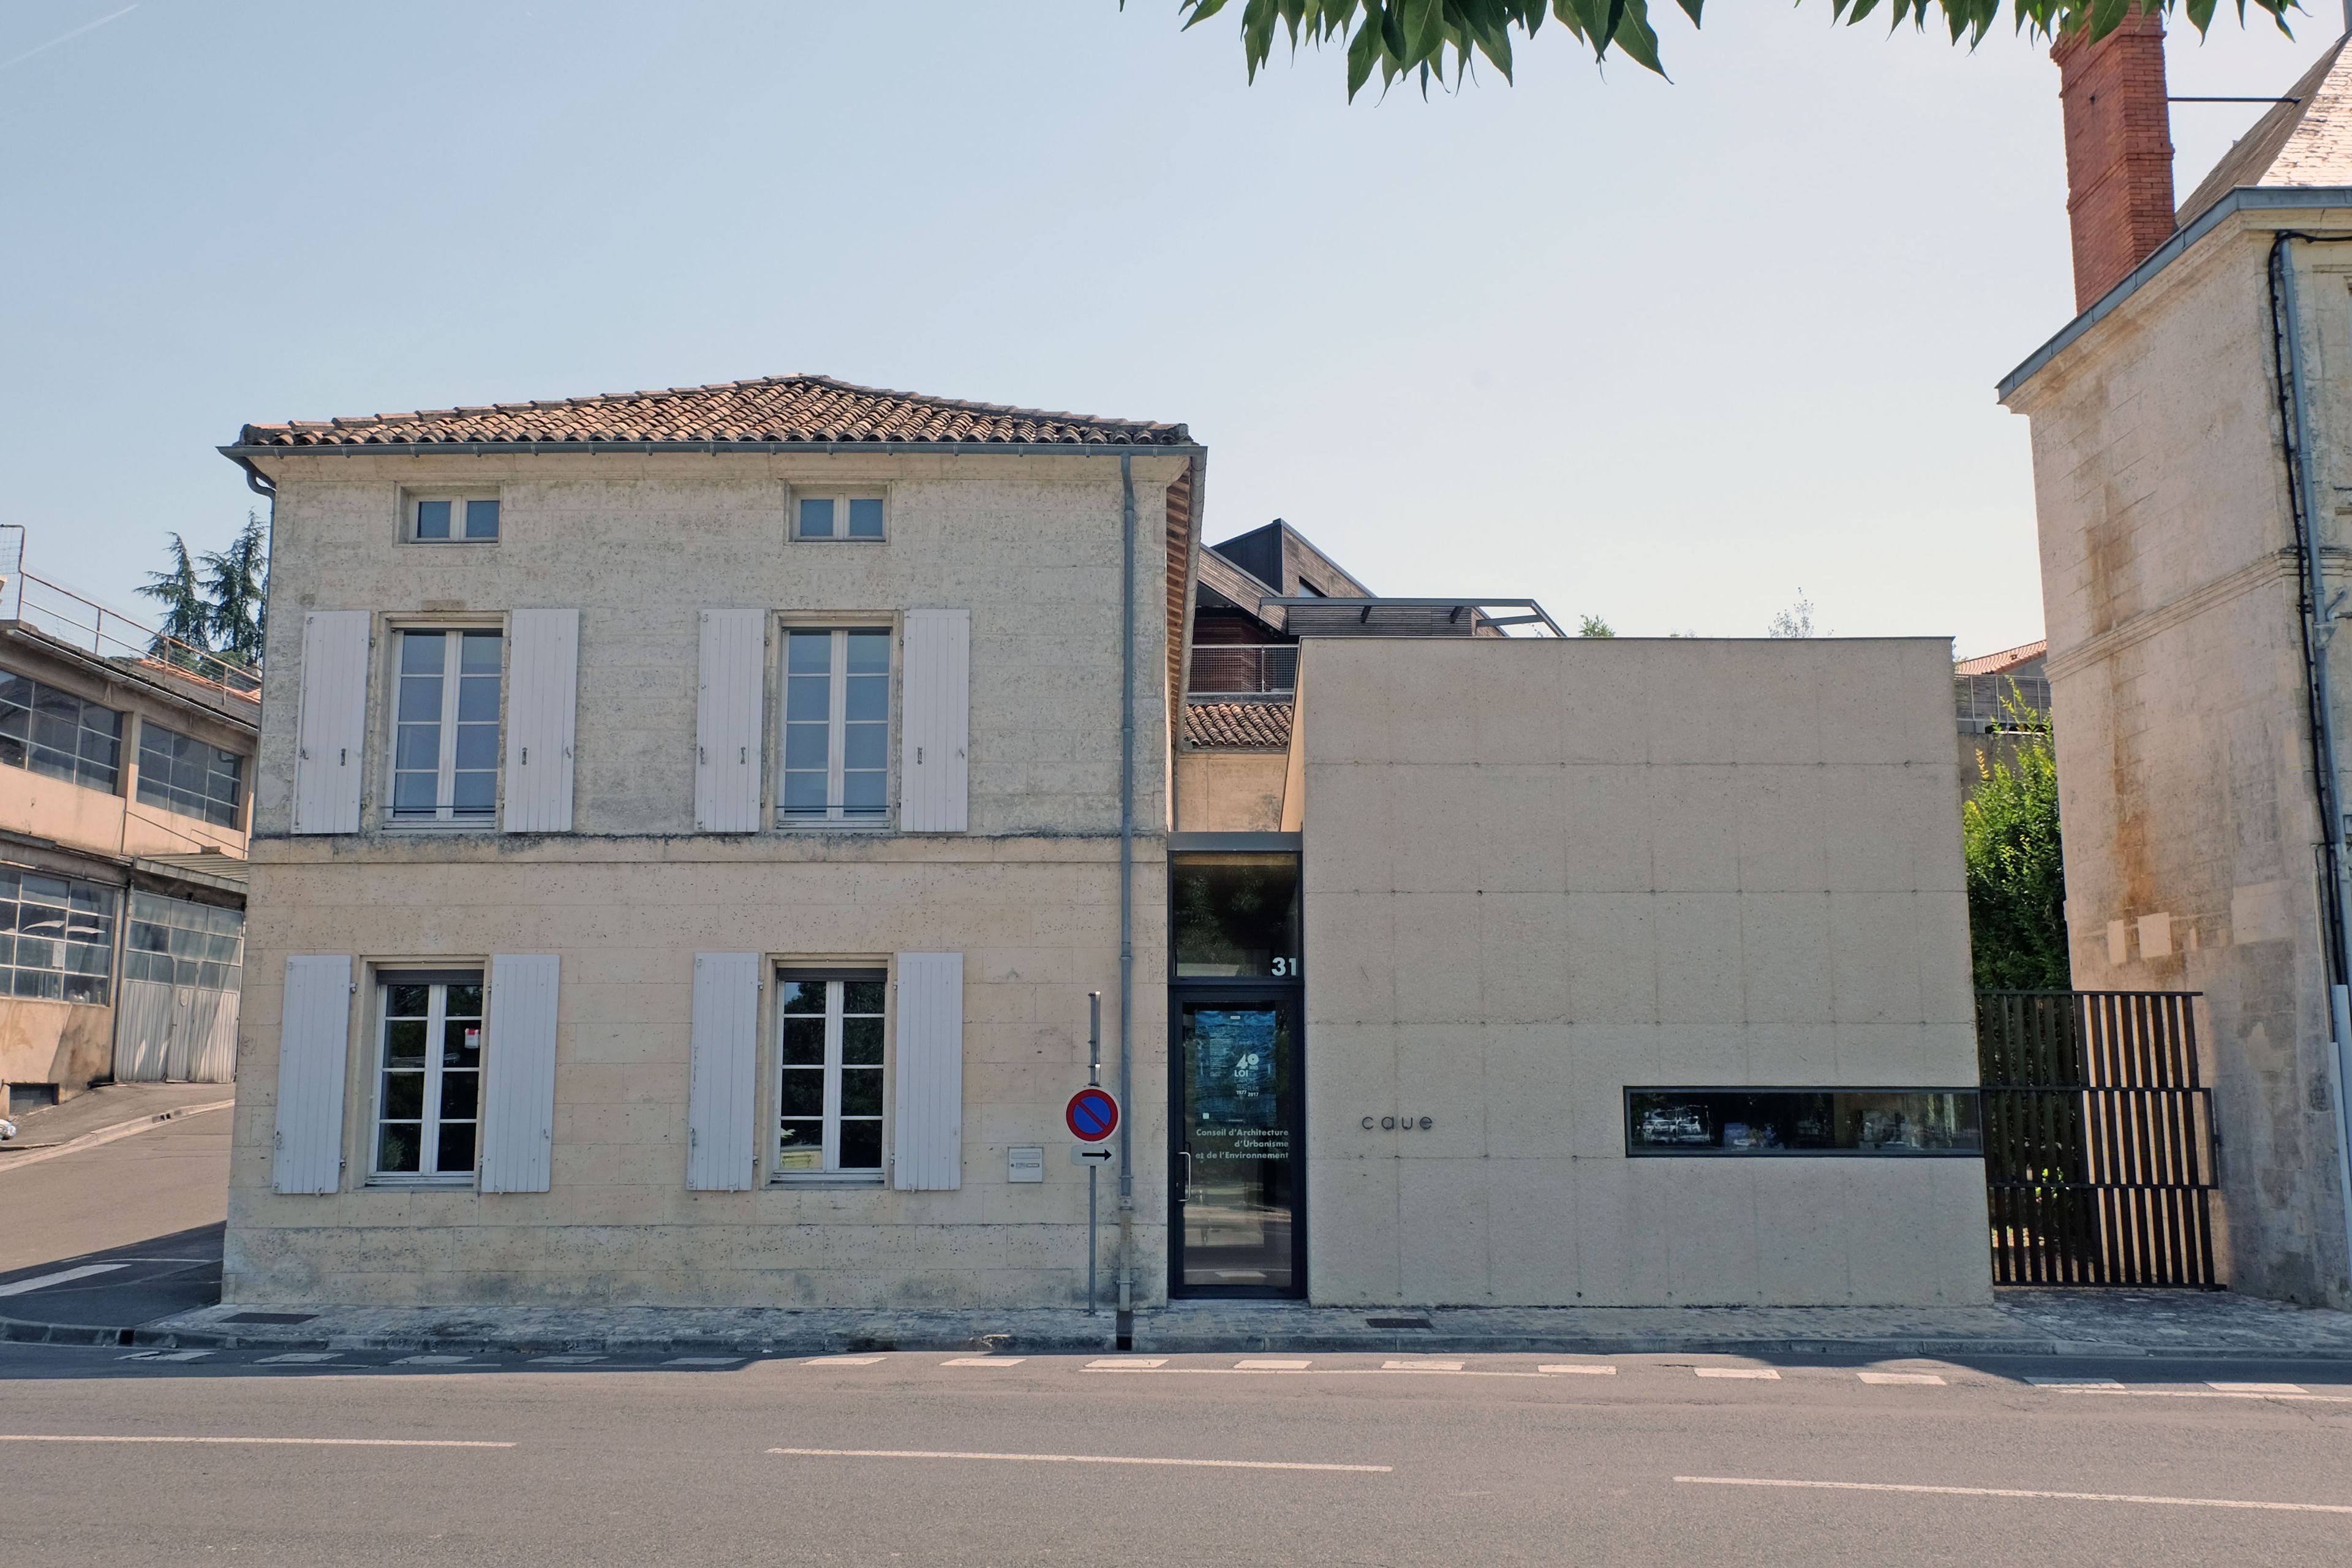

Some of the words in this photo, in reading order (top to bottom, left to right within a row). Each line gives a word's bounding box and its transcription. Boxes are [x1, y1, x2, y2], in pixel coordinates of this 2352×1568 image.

[1271, 957, 1297, 976] 31
[1236, 1054, 1259, 1069] 40
[1362, 1116, 1433, 1130] caue
